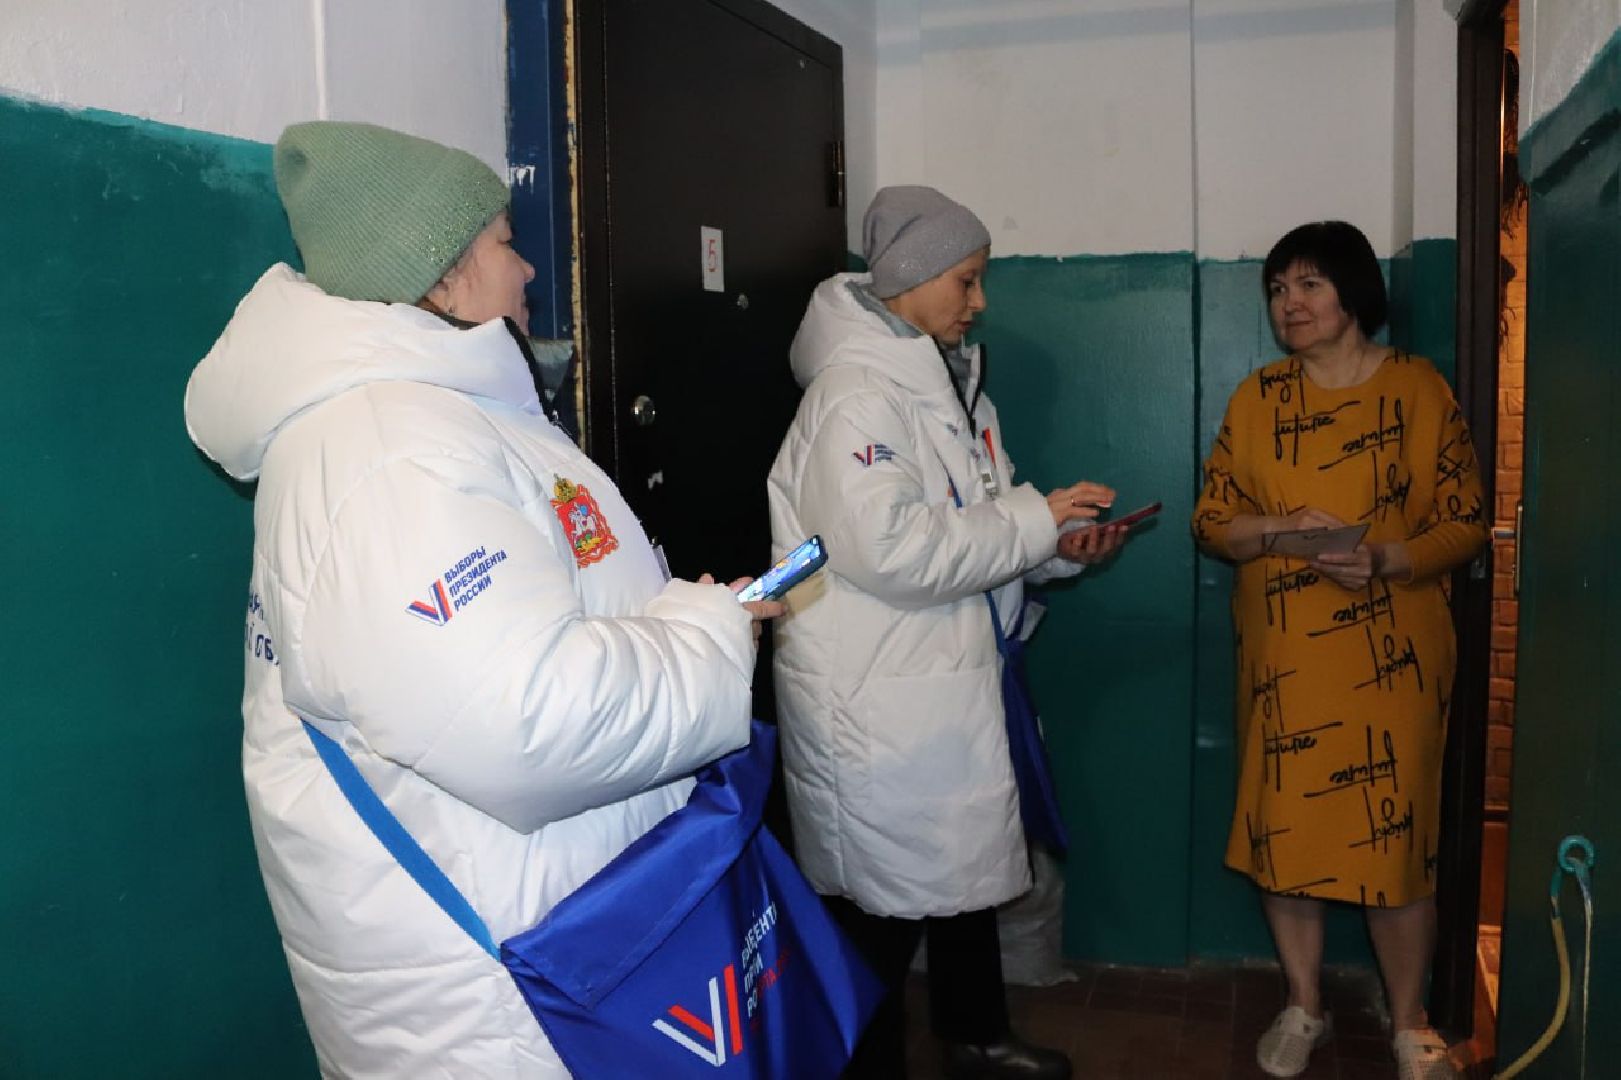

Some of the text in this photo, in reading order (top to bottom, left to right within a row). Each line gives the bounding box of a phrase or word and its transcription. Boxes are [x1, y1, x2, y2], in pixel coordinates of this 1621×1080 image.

[444, 546, 486, 583] ВЫБОРЫ
[449, 550, 507, 597] ПРЕЗИДЕНТА
[454, 574, 492, 612] РОССИИ
